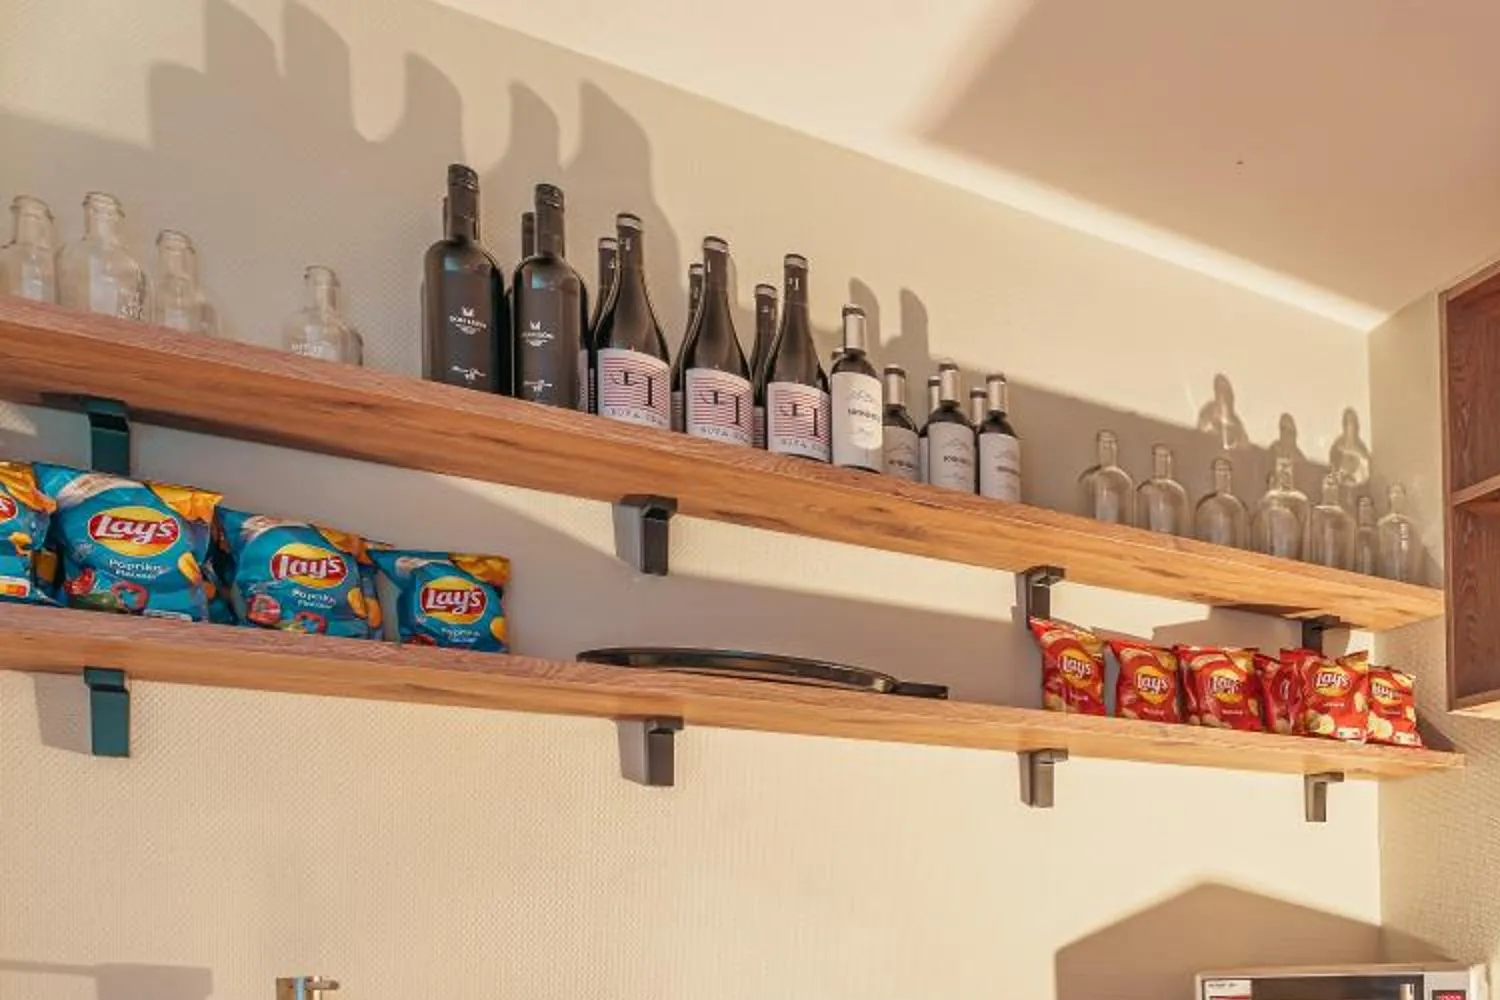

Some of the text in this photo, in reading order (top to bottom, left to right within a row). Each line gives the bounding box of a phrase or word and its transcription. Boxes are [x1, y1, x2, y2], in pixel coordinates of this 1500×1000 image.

[95, 514, 173, 545] Lay's
[279, 554, 341, 579] Lay's
[425, 587, 483, 615] Lay's
